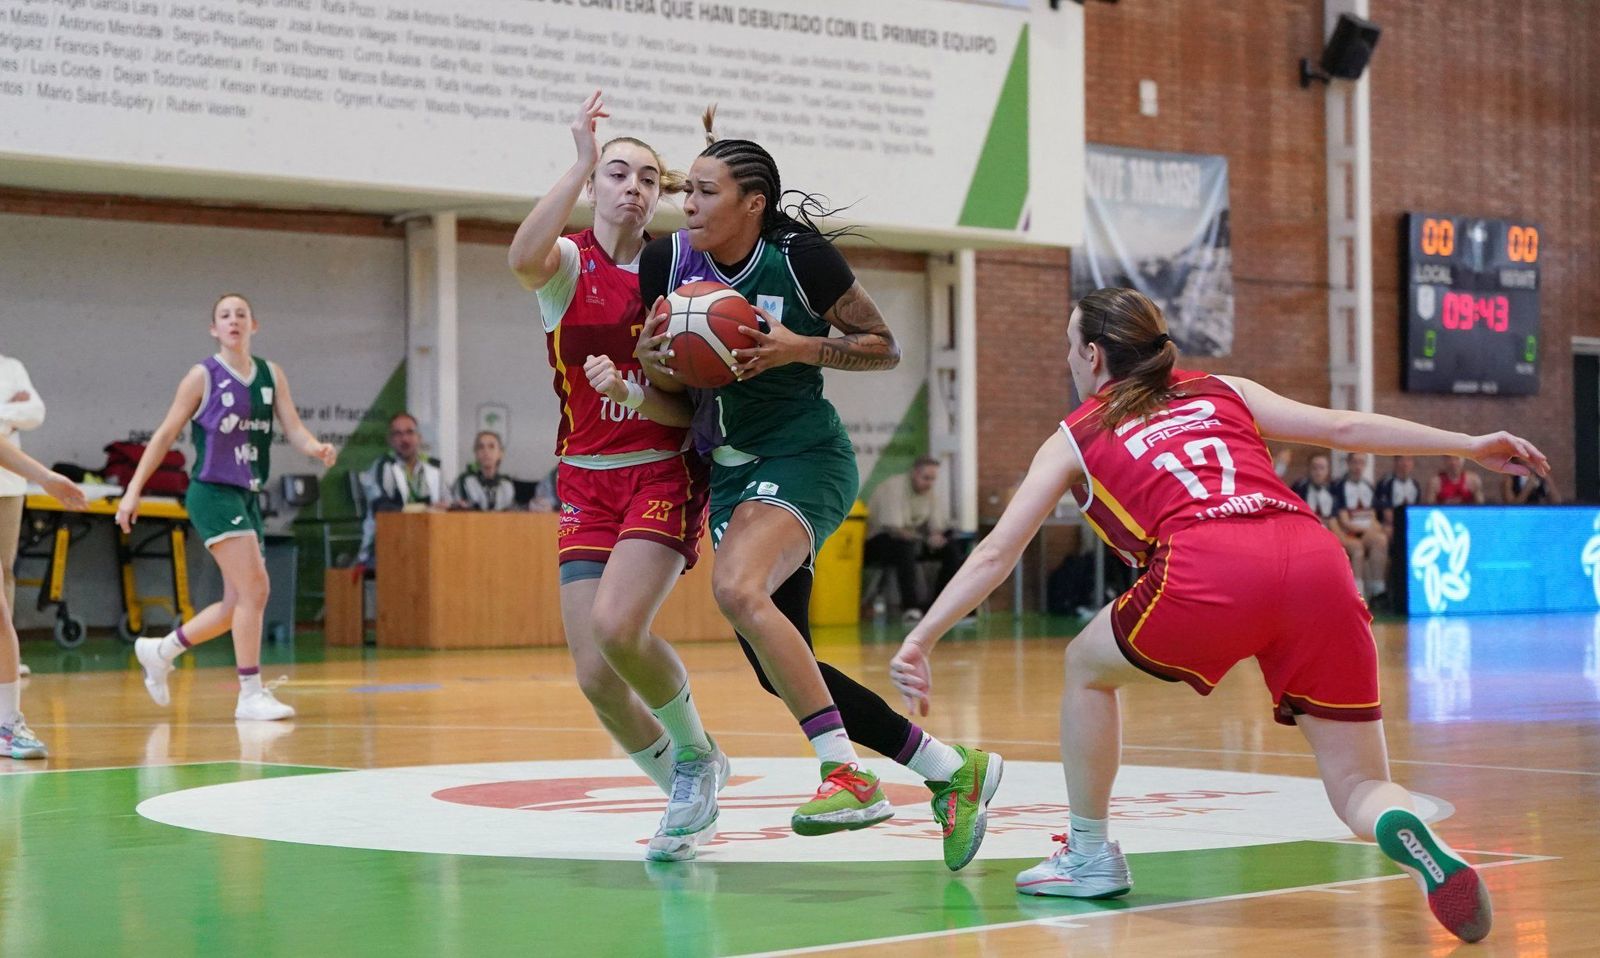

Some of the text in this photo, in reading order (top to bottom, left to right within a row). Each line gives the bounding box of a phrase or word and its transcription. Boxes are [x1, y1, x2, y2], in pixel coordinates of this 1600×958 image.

[661, 1, 693, 20] QUE
[699, 5, 734, 24] HAN
[738, 8, 821, 36] DEBUTADO
[825, 17, 857, 39] CON
[861, 22, 879, 41] EL
[882, 24, 939, 47] PRIMER
[943, 32, 997, 54] EQUIPO
[1422, 218, 1454, 256] 00
[1507, 225, 1539, 263] 00
[1442, 291, 1509, 332] 09:43
[1151, 436, 1237, 500] 17
[641, 500, 673, 522] 23
